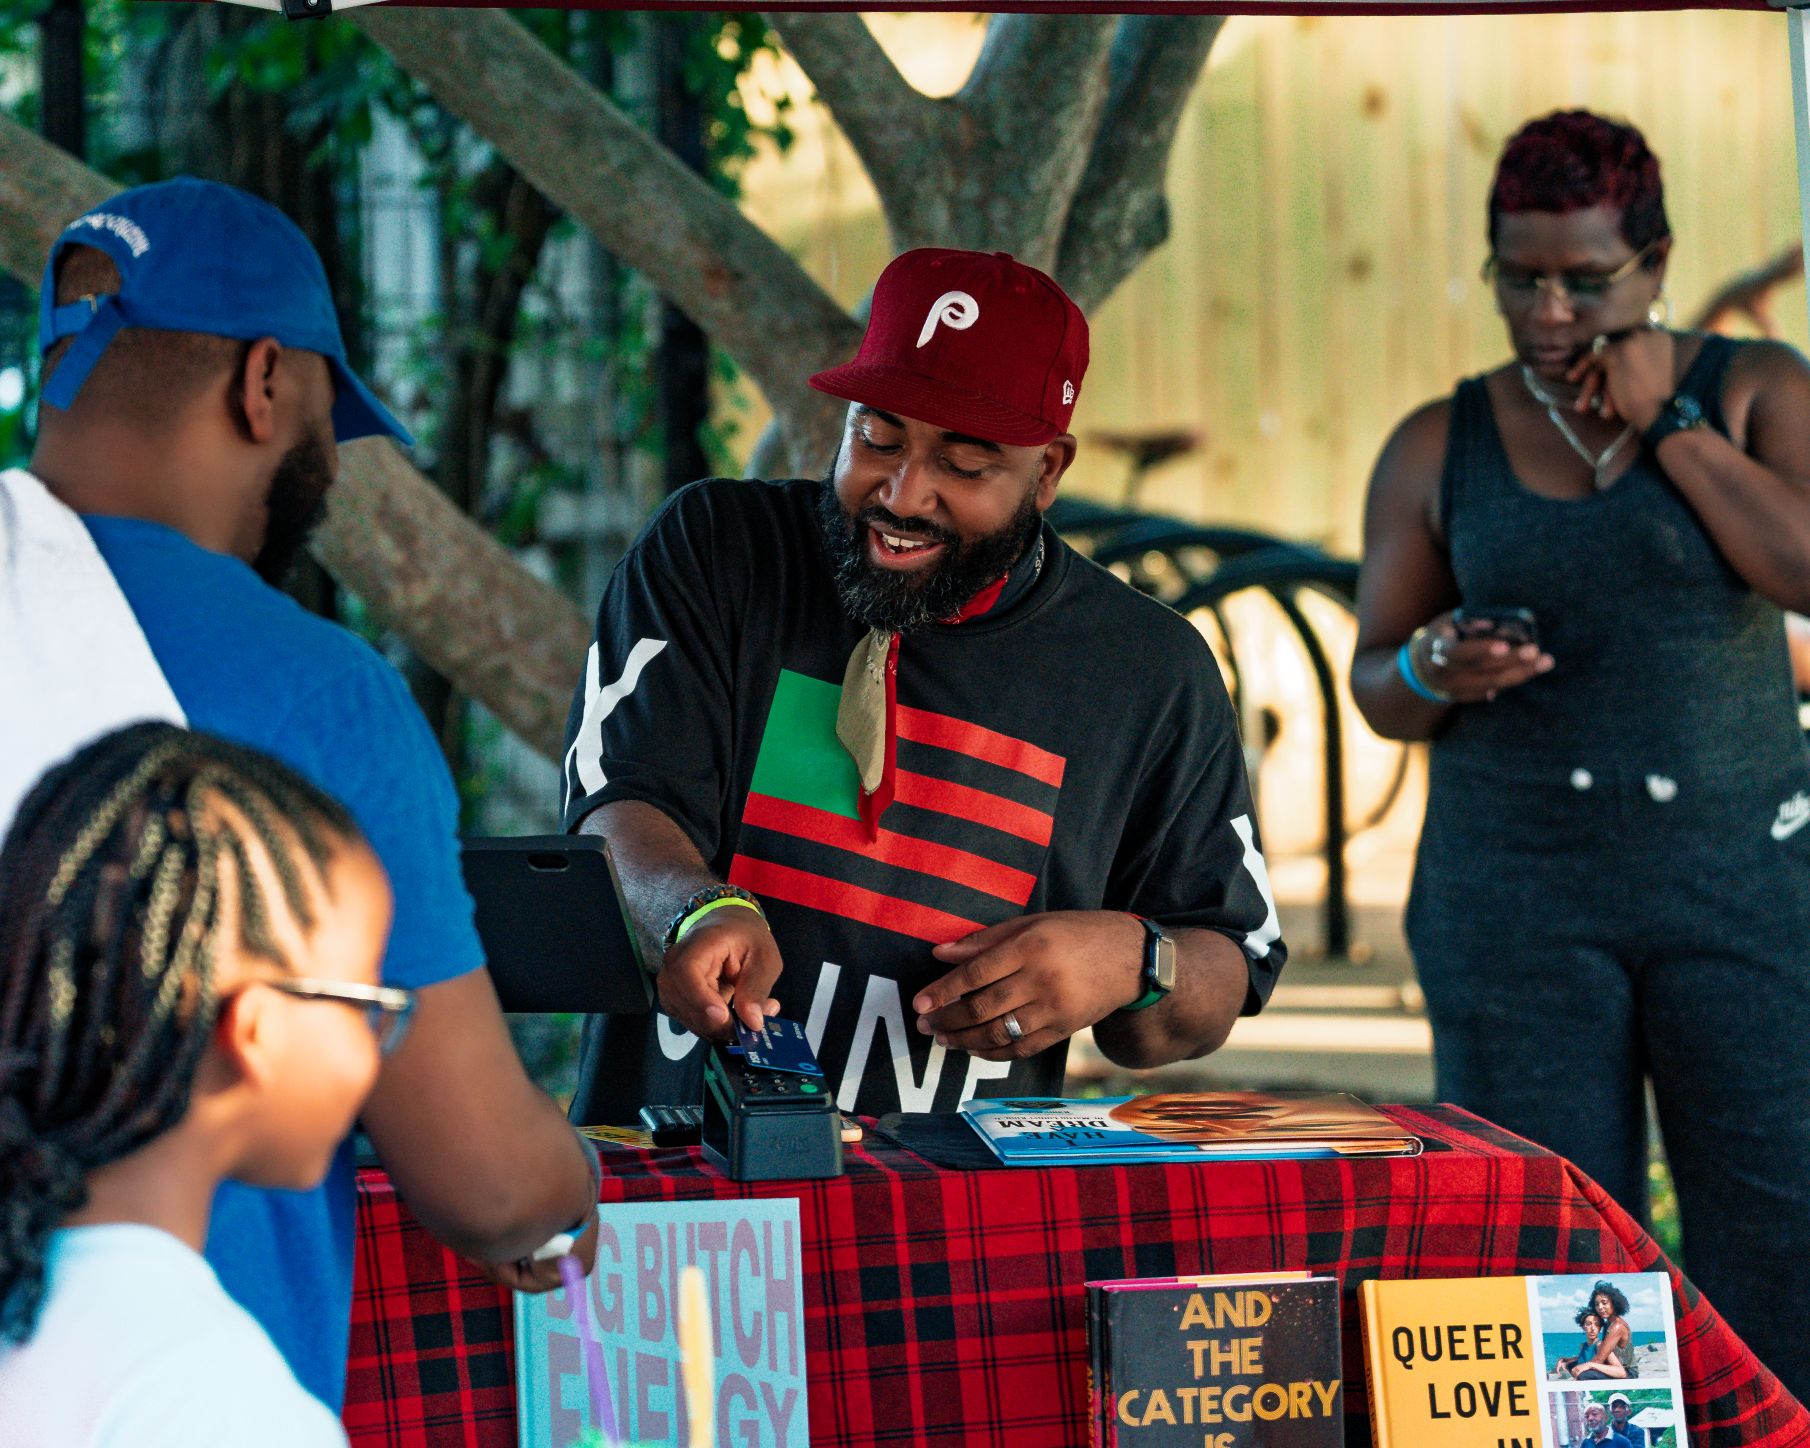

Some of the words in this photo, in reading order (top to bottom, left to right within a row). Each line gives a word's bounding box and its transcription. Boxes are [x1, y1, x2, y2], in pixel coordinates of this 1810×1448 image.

[916, 290, 980, 348] P
[748, 1051, 761, 1064] VISA
[1023, 1132, 1105, 1140] HAVE
[635, 1218, 799, 1376] BUTCH
[1179, 1290, 1273, 1331] AND
[1186, 1336, 1264, 1379] THE
[1392, 1323, 1524, 1370] QUEER
[547, 1331, 798, 1448] ENEGY
[1117, 1379, 1340, 1427] CATEGORY
[1428, 1380, 1530, 1419] LOVE
